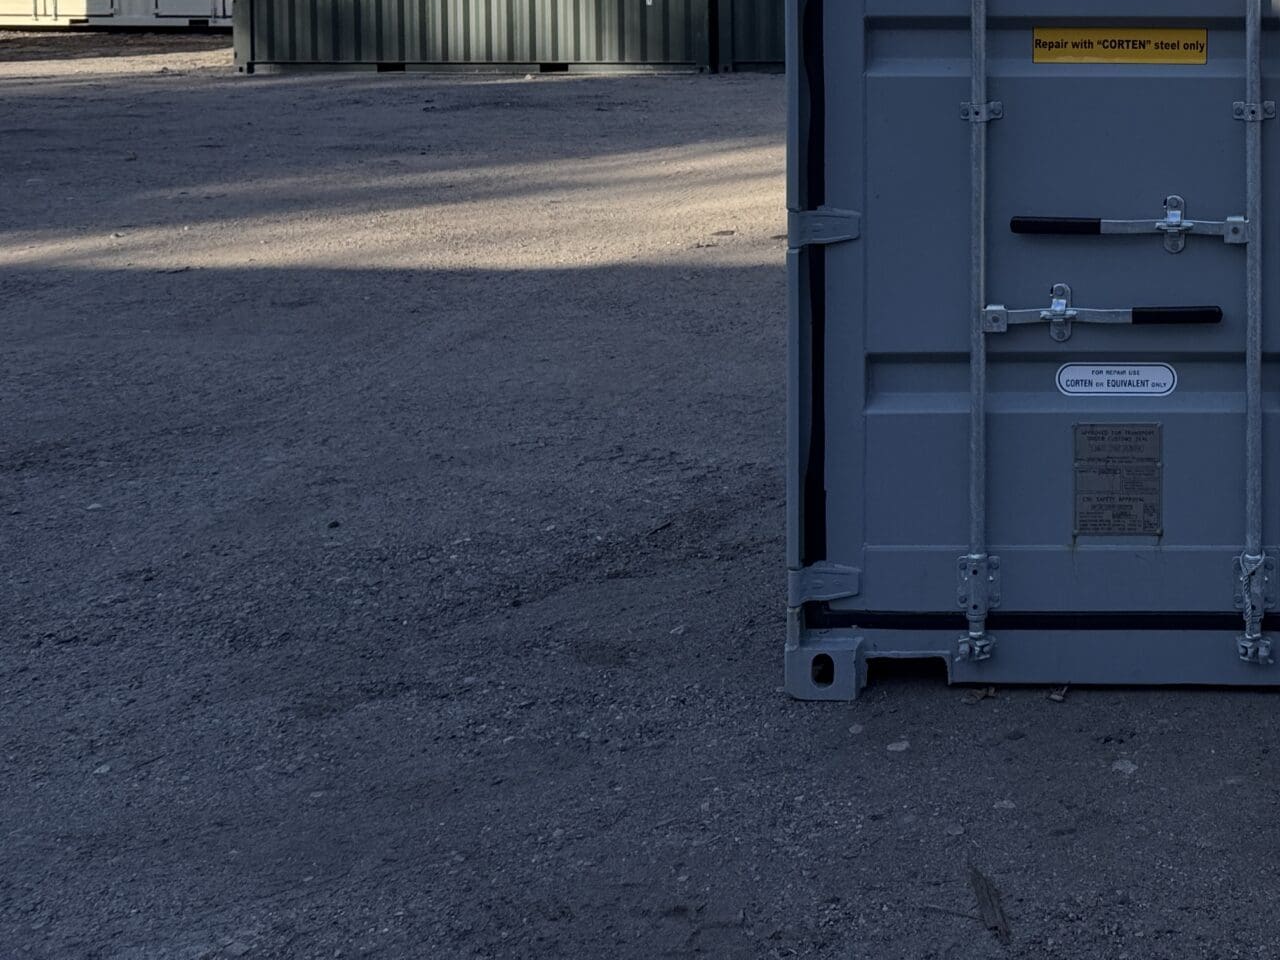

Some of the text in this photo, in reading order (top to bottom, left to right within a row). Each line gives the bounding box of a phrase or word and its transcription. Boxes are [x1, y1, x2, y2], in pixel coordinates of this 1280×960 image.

[1034, 38, 1069, 51] Repair
[1071, 39, 1094, 49] with
[1154, 40, 1180, 50] steel
[1183, 40, 1206, 53] only
[1065, 379, 1093, 388] CORTEN
[1106, 379, 1150, 388] EQUIVALENT
